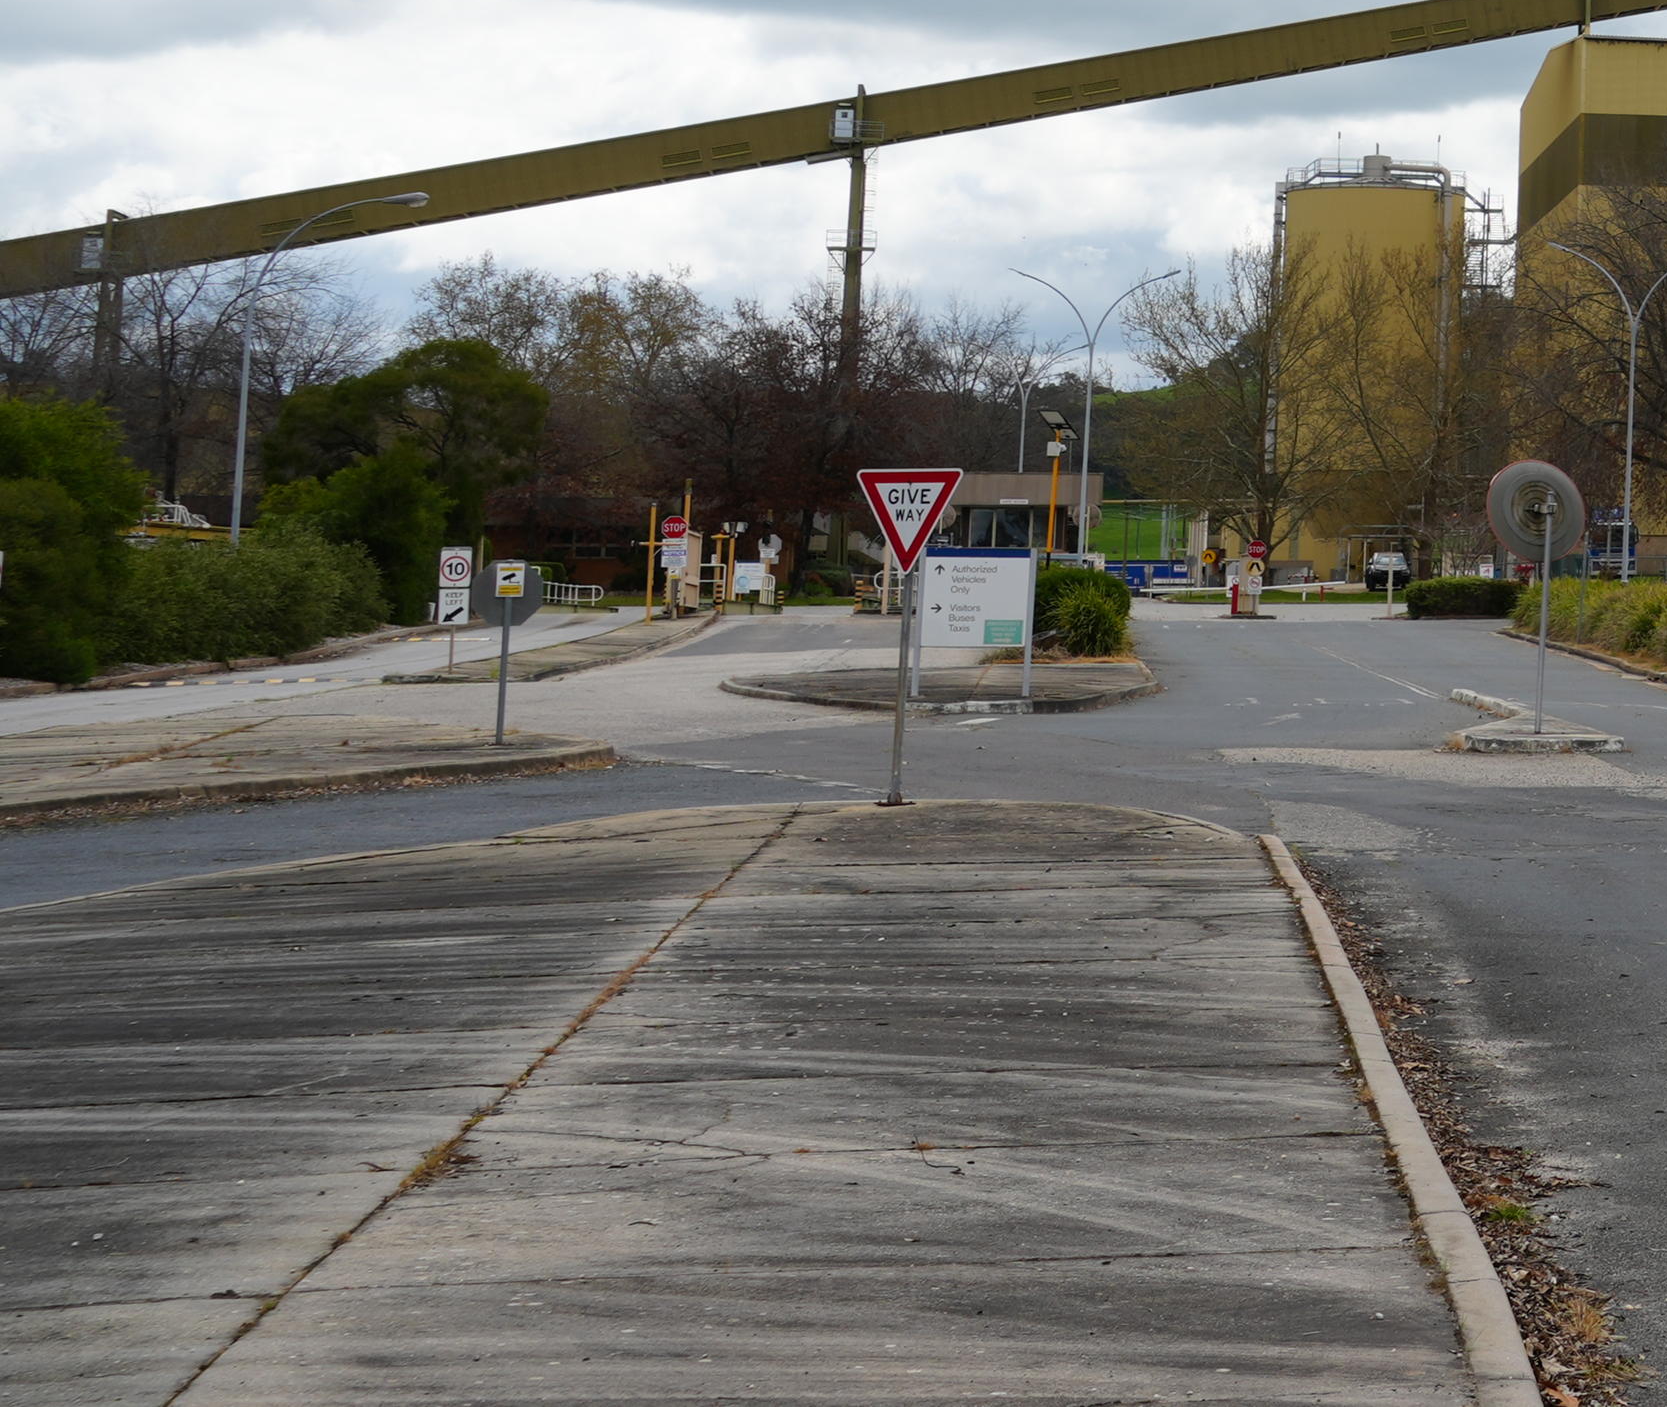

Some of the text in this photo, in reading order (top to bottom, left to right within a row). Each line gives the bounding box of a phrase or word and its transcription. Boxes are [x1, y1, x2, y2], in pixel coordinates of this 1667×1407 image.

[888, 488, 931, 504] GIVE
[895, 509, 924, 521] WAY
[664, 523, 686, 532] STOP
[446, 562, 465, 575] 10
[951, 565, 998, 573] Authorized
[950, 585, 970, 594] Only
[949, 604, 980, 612] Visitors
[948, 614, 975, 622] Buses
[948, 624, 970, 632] Taxis
